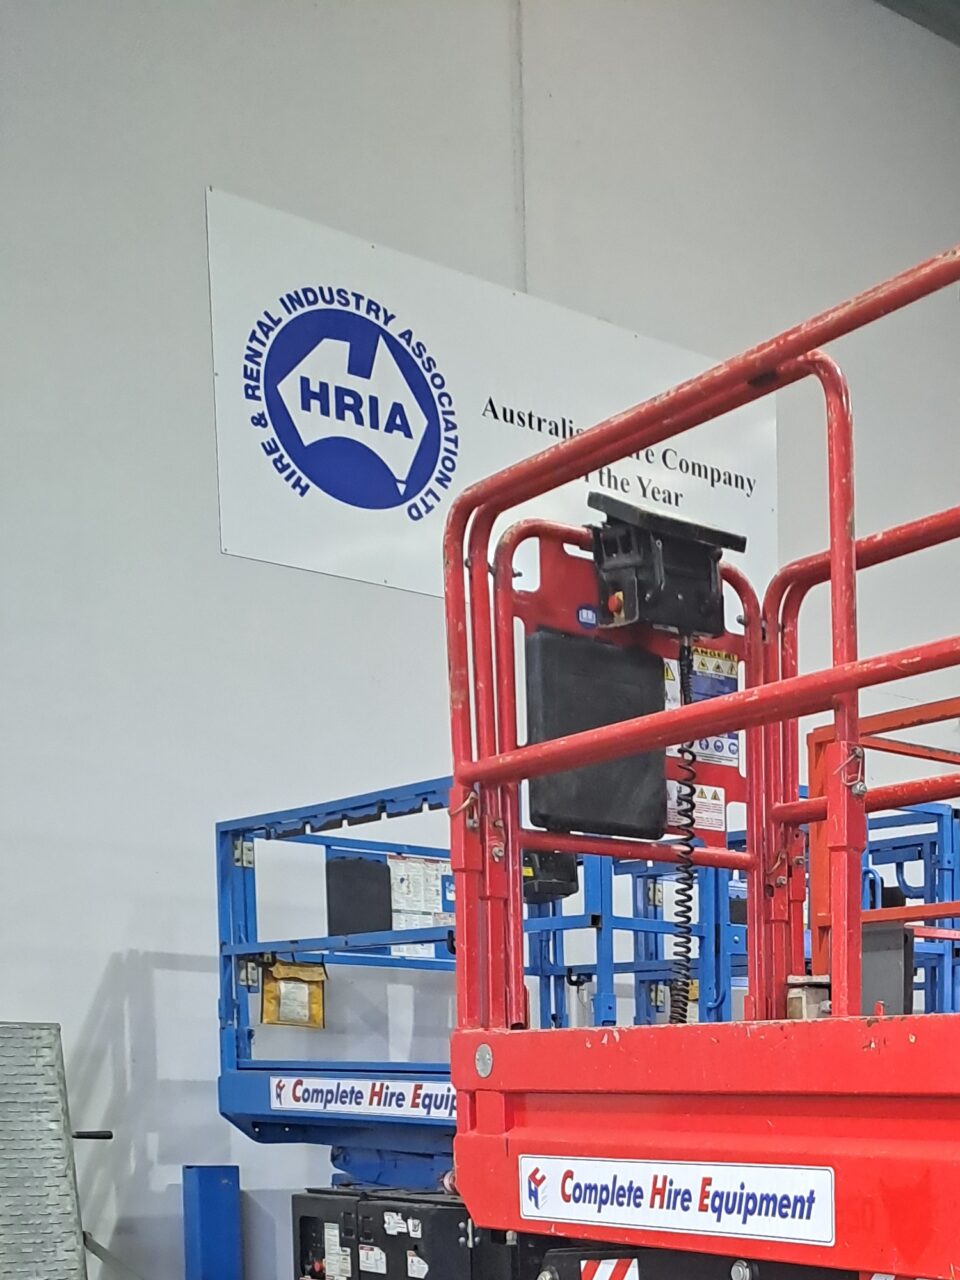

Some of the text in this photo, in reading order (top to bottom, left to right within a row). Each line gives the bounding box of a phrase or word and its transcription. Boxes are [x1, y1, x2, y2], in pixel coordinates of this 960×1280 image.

[243, 286, 459, 521] HIRE & RENTAL INDUSTRY ASSOCIATION LTD
[299, 375, 414, 440] HRIA
[598, 466, 684, 507] the Year
[661, 448, 757, 497] Company
[291, 1079, 364, 1109] Complete
[368, 1082, 406, 1109] Hire
[560, 1169, 816, 1225] Complete Hire Equipment
